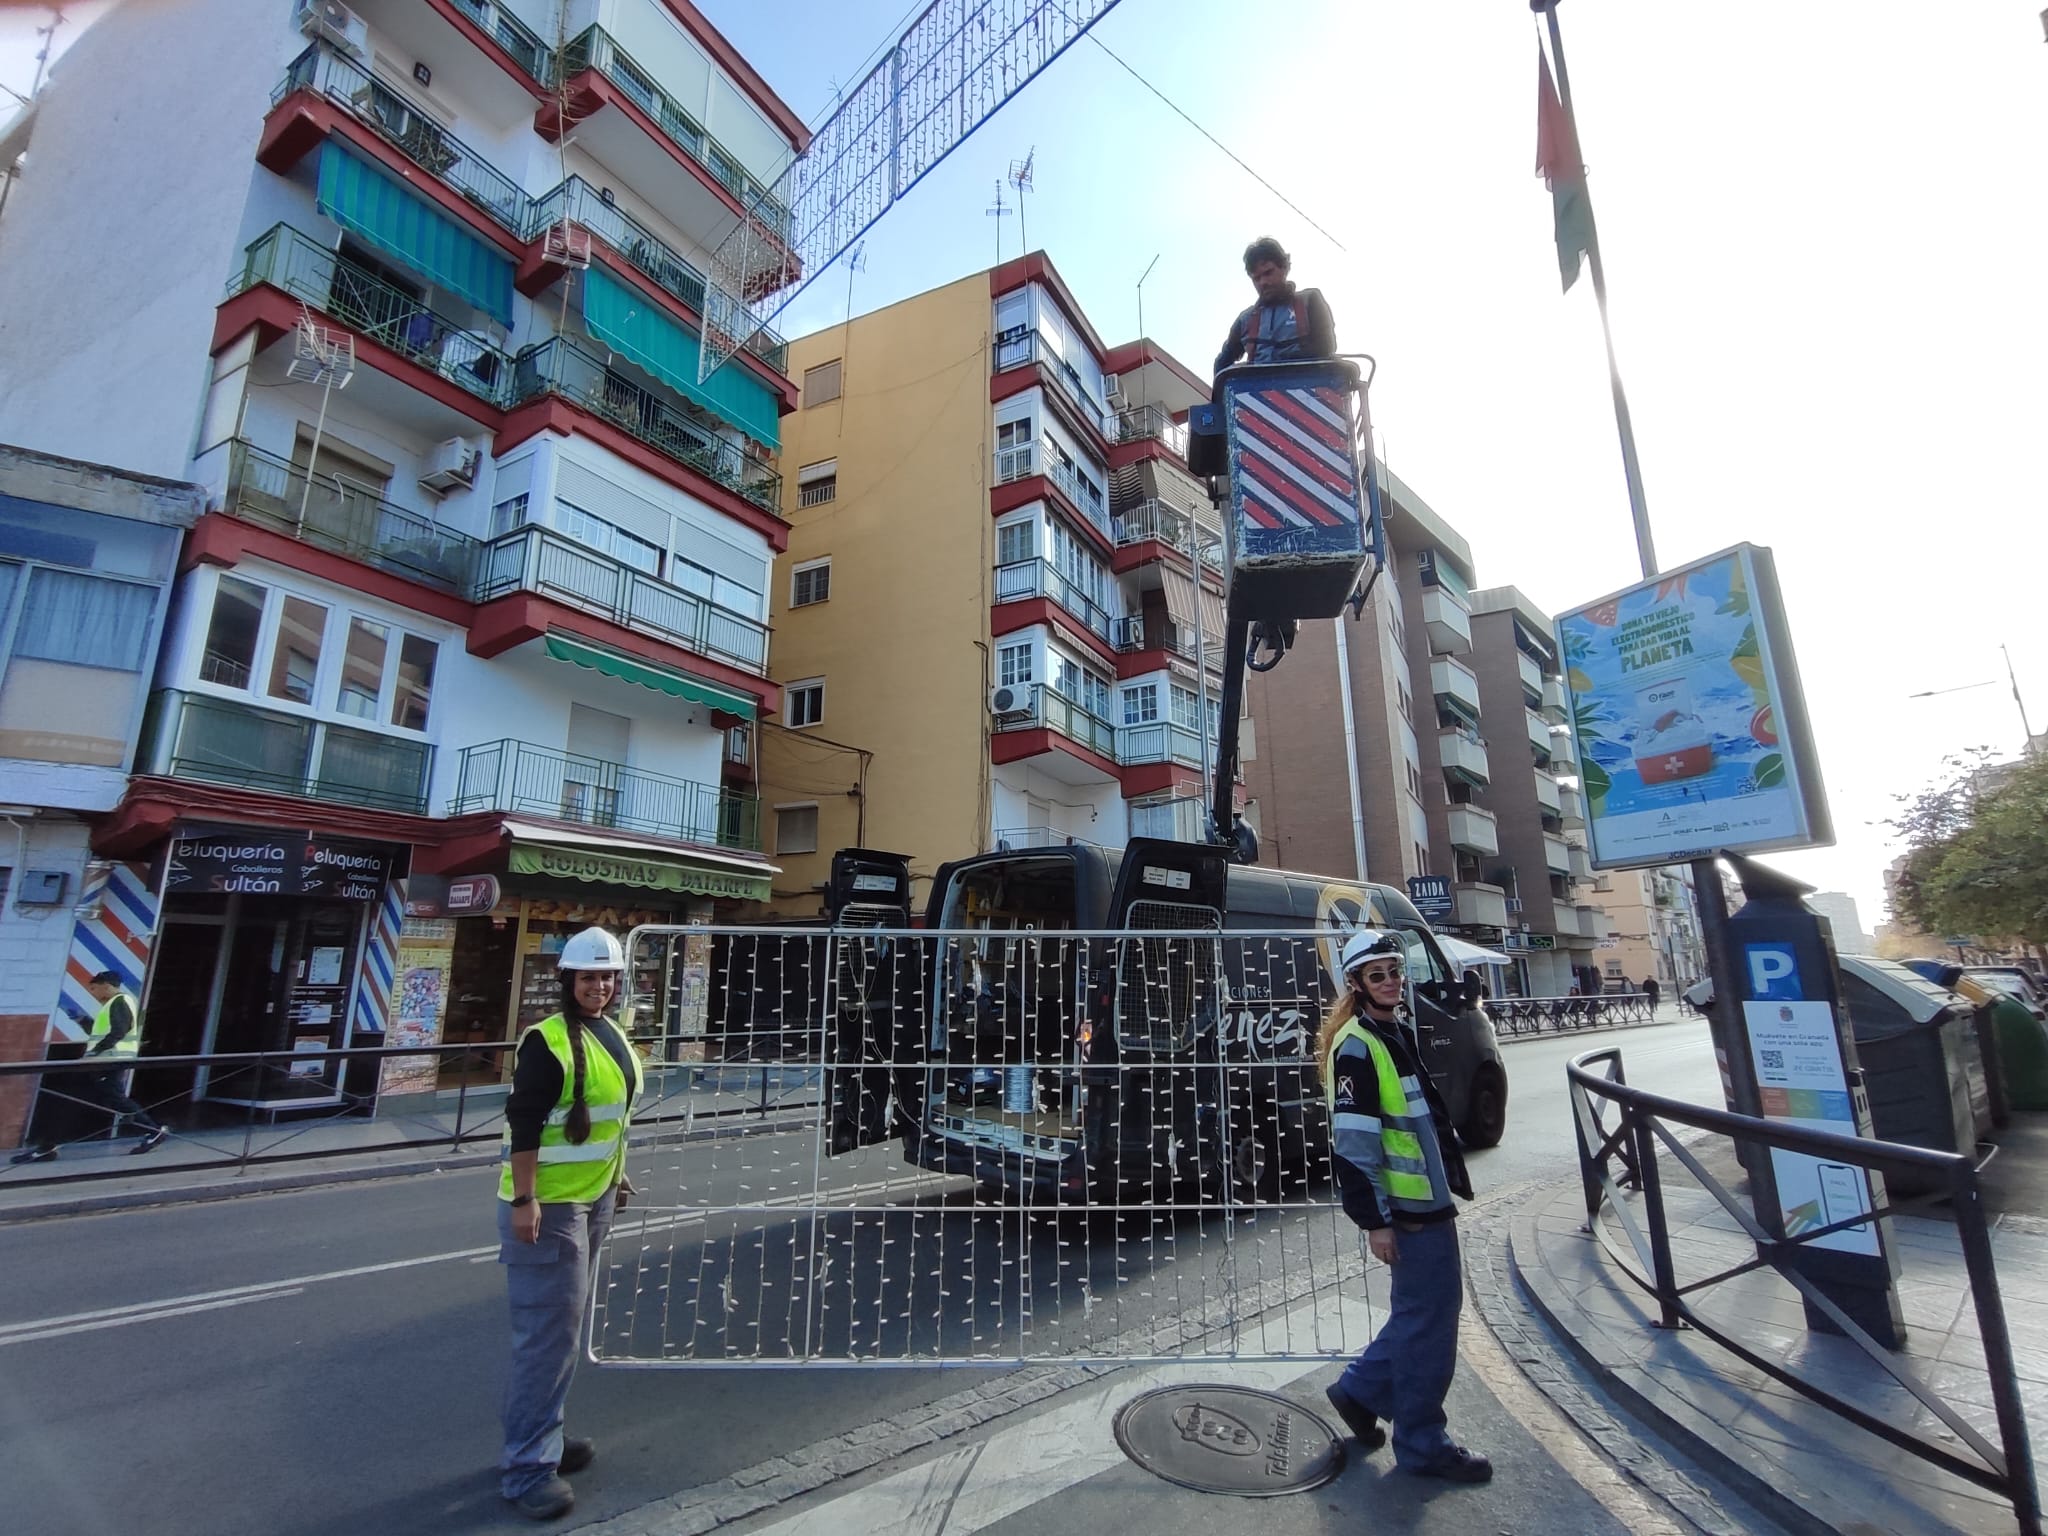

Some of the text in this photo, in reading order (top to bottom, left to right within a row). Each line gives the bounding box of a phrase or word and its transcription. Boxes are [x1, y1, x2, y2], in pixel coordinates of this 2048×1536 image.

[1621, 638, 1694, 674] PLANETA
[178, 842, 285, 862] eluquería
[304, 845, 381, 871] Peluquería
[232, 864, 284, 874] Caballeros
[541, 854, 658, 883] GOLOSINAS
[210, 875, 280, 893] Sultán
[334, 881, 376, 900] Sultán
[1415, 881, 1445, 897] ZAIDA
[1749, 951, 1794, 993] P
[1231, 986, 1269, 998] CIONES
[1265, 1410, 1292, 1477] Telefónica
